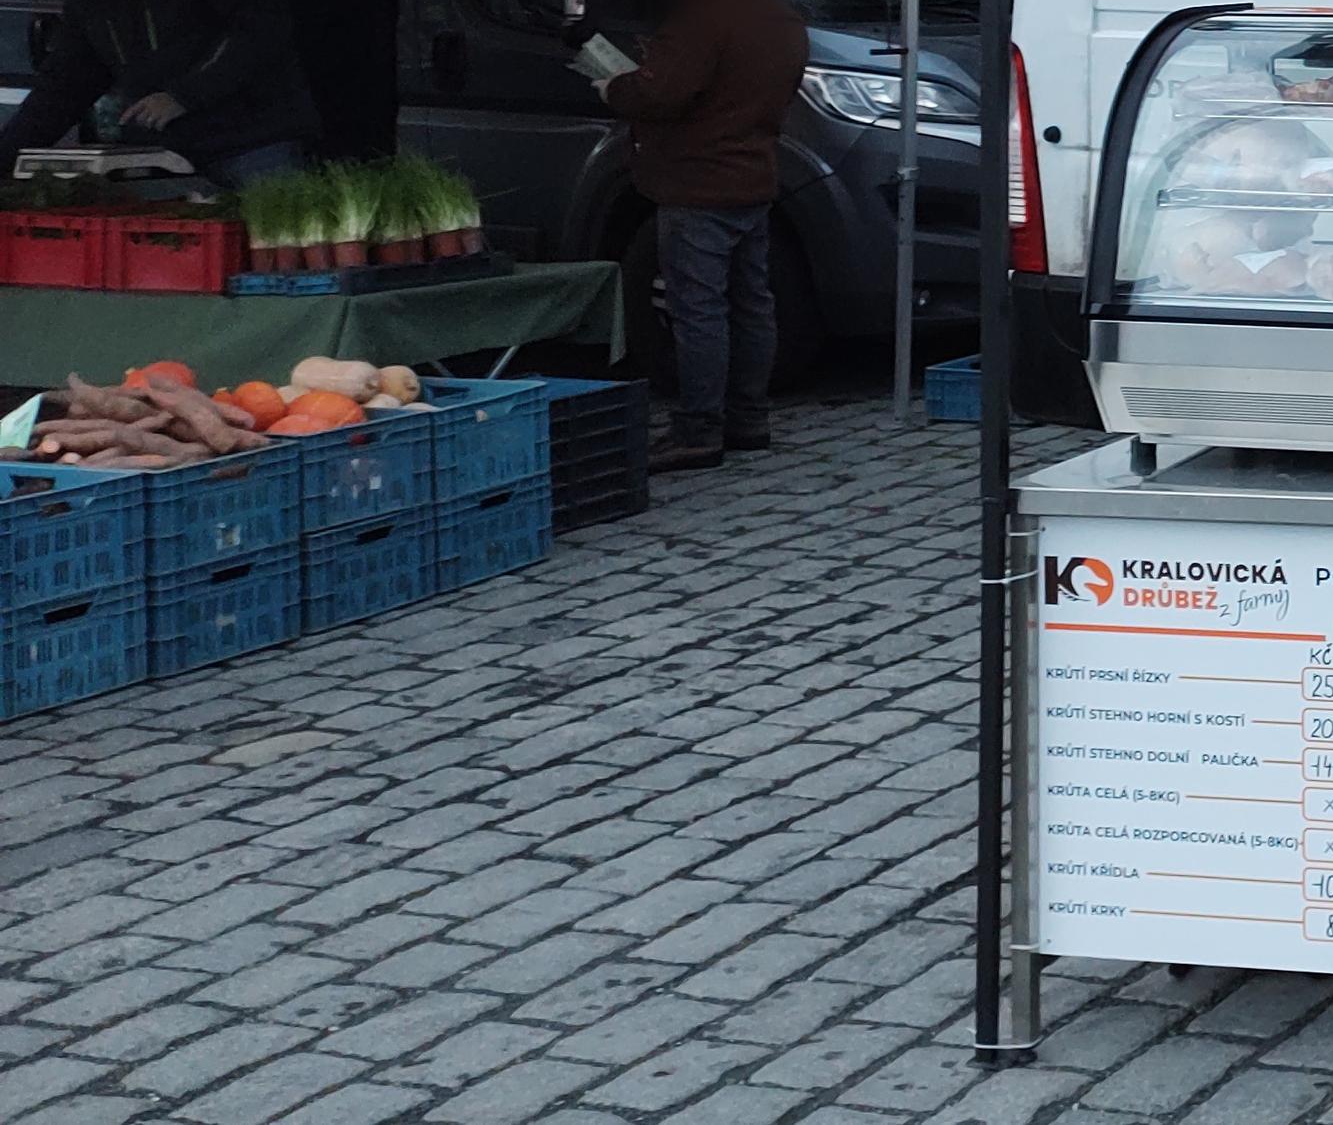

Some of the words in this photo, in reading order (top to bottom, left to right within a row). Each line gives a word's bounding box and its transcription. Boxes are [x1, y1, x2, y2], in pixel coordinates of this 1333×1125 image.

[1122, 559, 1288, 585] KRALOVICKÁ
[1123, 582, 1218, 610] DRŮBEŽ
[1231, 589, 1290, 626] farmy
[1088, 669, 1129, 683] PRSNÍ
[1088, 709, 1143, 722] STEHNO
[1147, 710, 1191, 725] HORNÍ
[1194, 713, 1202, 725] S
[1206, 713, 1245, 727] KOSTÍ
[1089, 748, 1143, 761] STEHNO
[1147, 749, 1190, 763] DOLNÍ
[1201, 752, 1259, 767] PALIČKA
[1095, 786, 1129, 800] CELÁ
[1095, 825, 1129, 839] CELÁ
[1133, 828, 1246, 845] ROZPORCOVANÁ
[1091, 905, 1126, 917] KRKY
